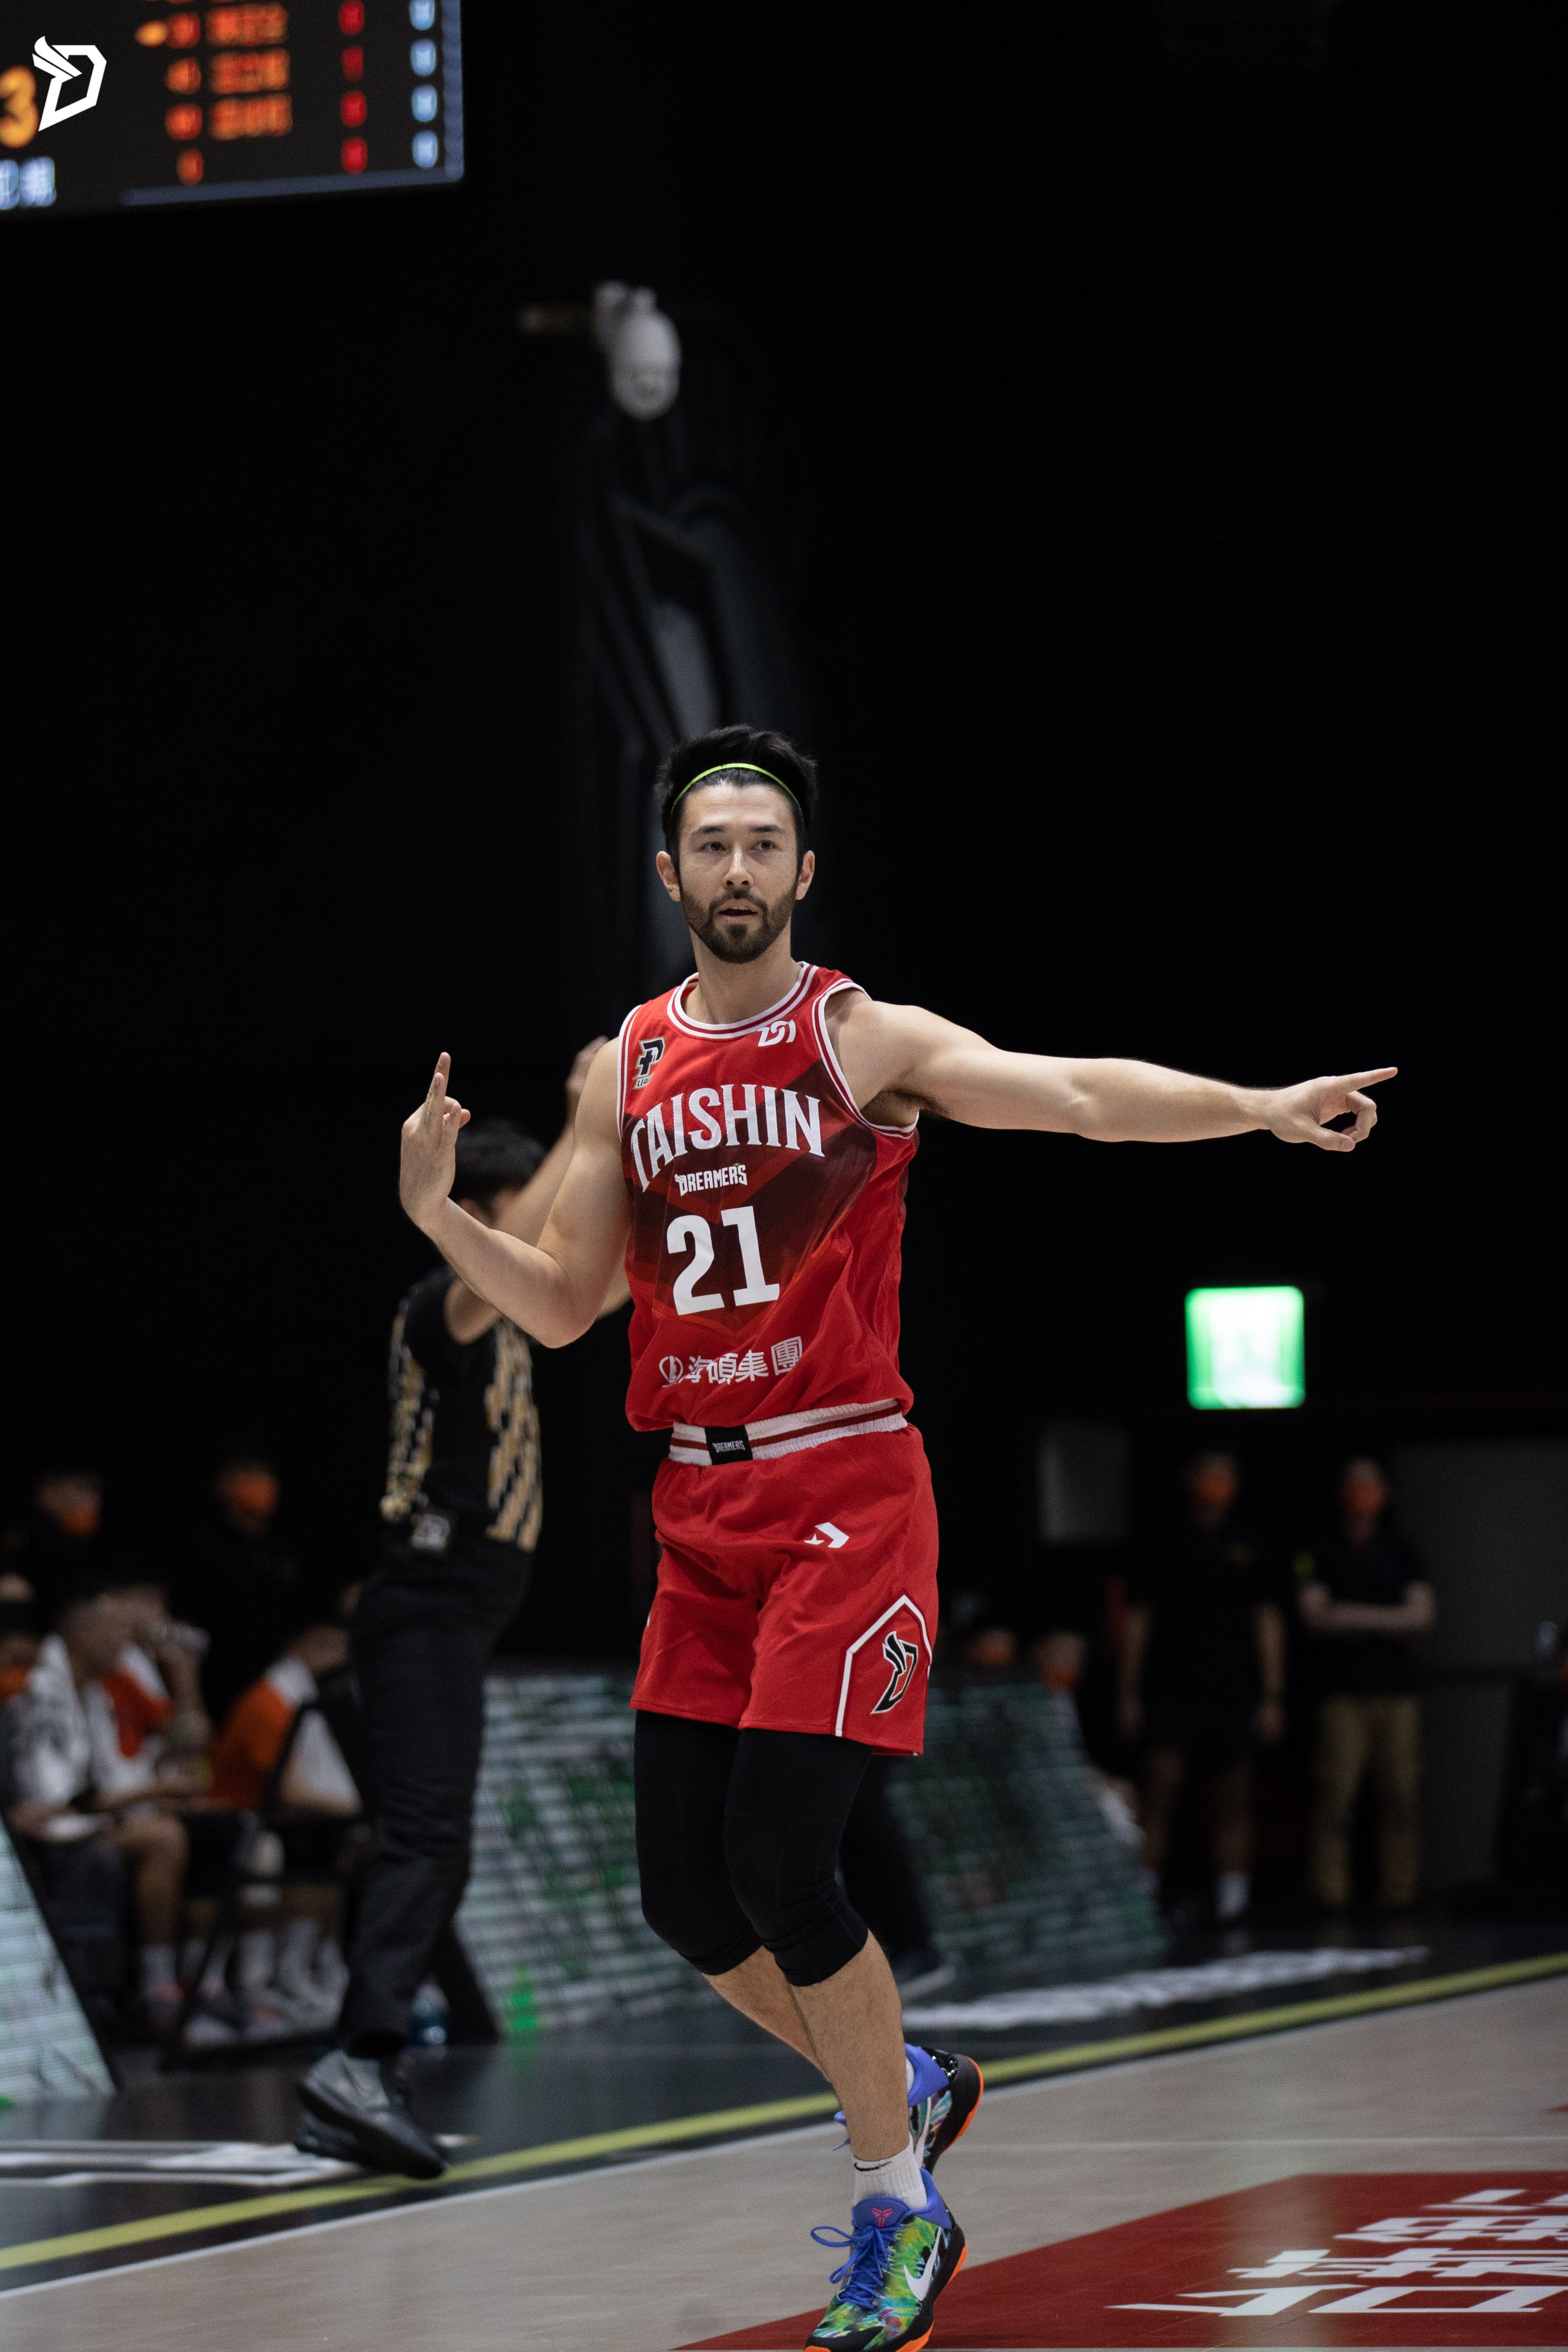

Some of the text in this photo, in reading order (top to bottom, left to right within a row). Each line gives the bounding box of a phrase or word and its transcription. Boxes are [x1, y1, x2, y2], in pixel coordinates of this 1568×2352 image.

[630, 1084, 825, 1192] TAISHIN
[674, 1164, 748, 1197] DREAMERS
[666, 1205, 780, 1316] 21
[712, 1440, 746, 1454] DREAMERS
